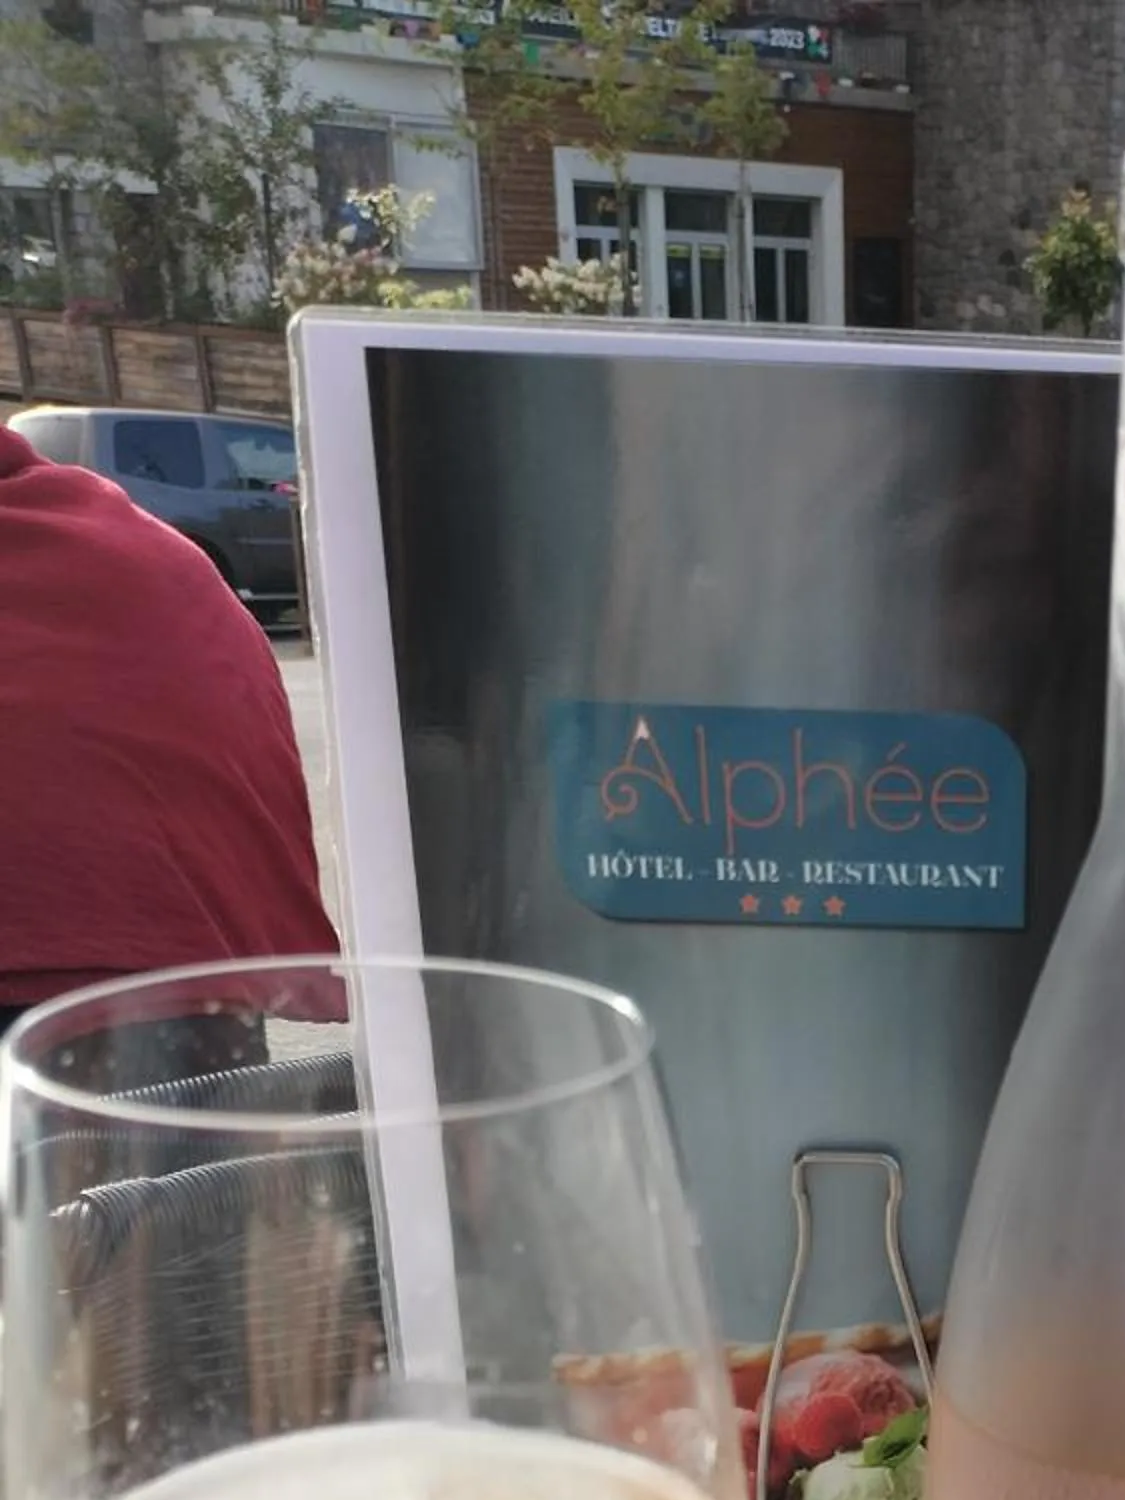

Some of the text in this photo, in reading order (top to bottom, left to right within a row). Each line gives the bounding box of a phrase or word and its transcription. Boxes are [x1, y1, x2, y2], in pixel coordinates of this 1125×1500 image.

[601, 715, 991, 856] Alphée
[587, 849, 1006, 890] HÔTEL BAR RESTAURANT
